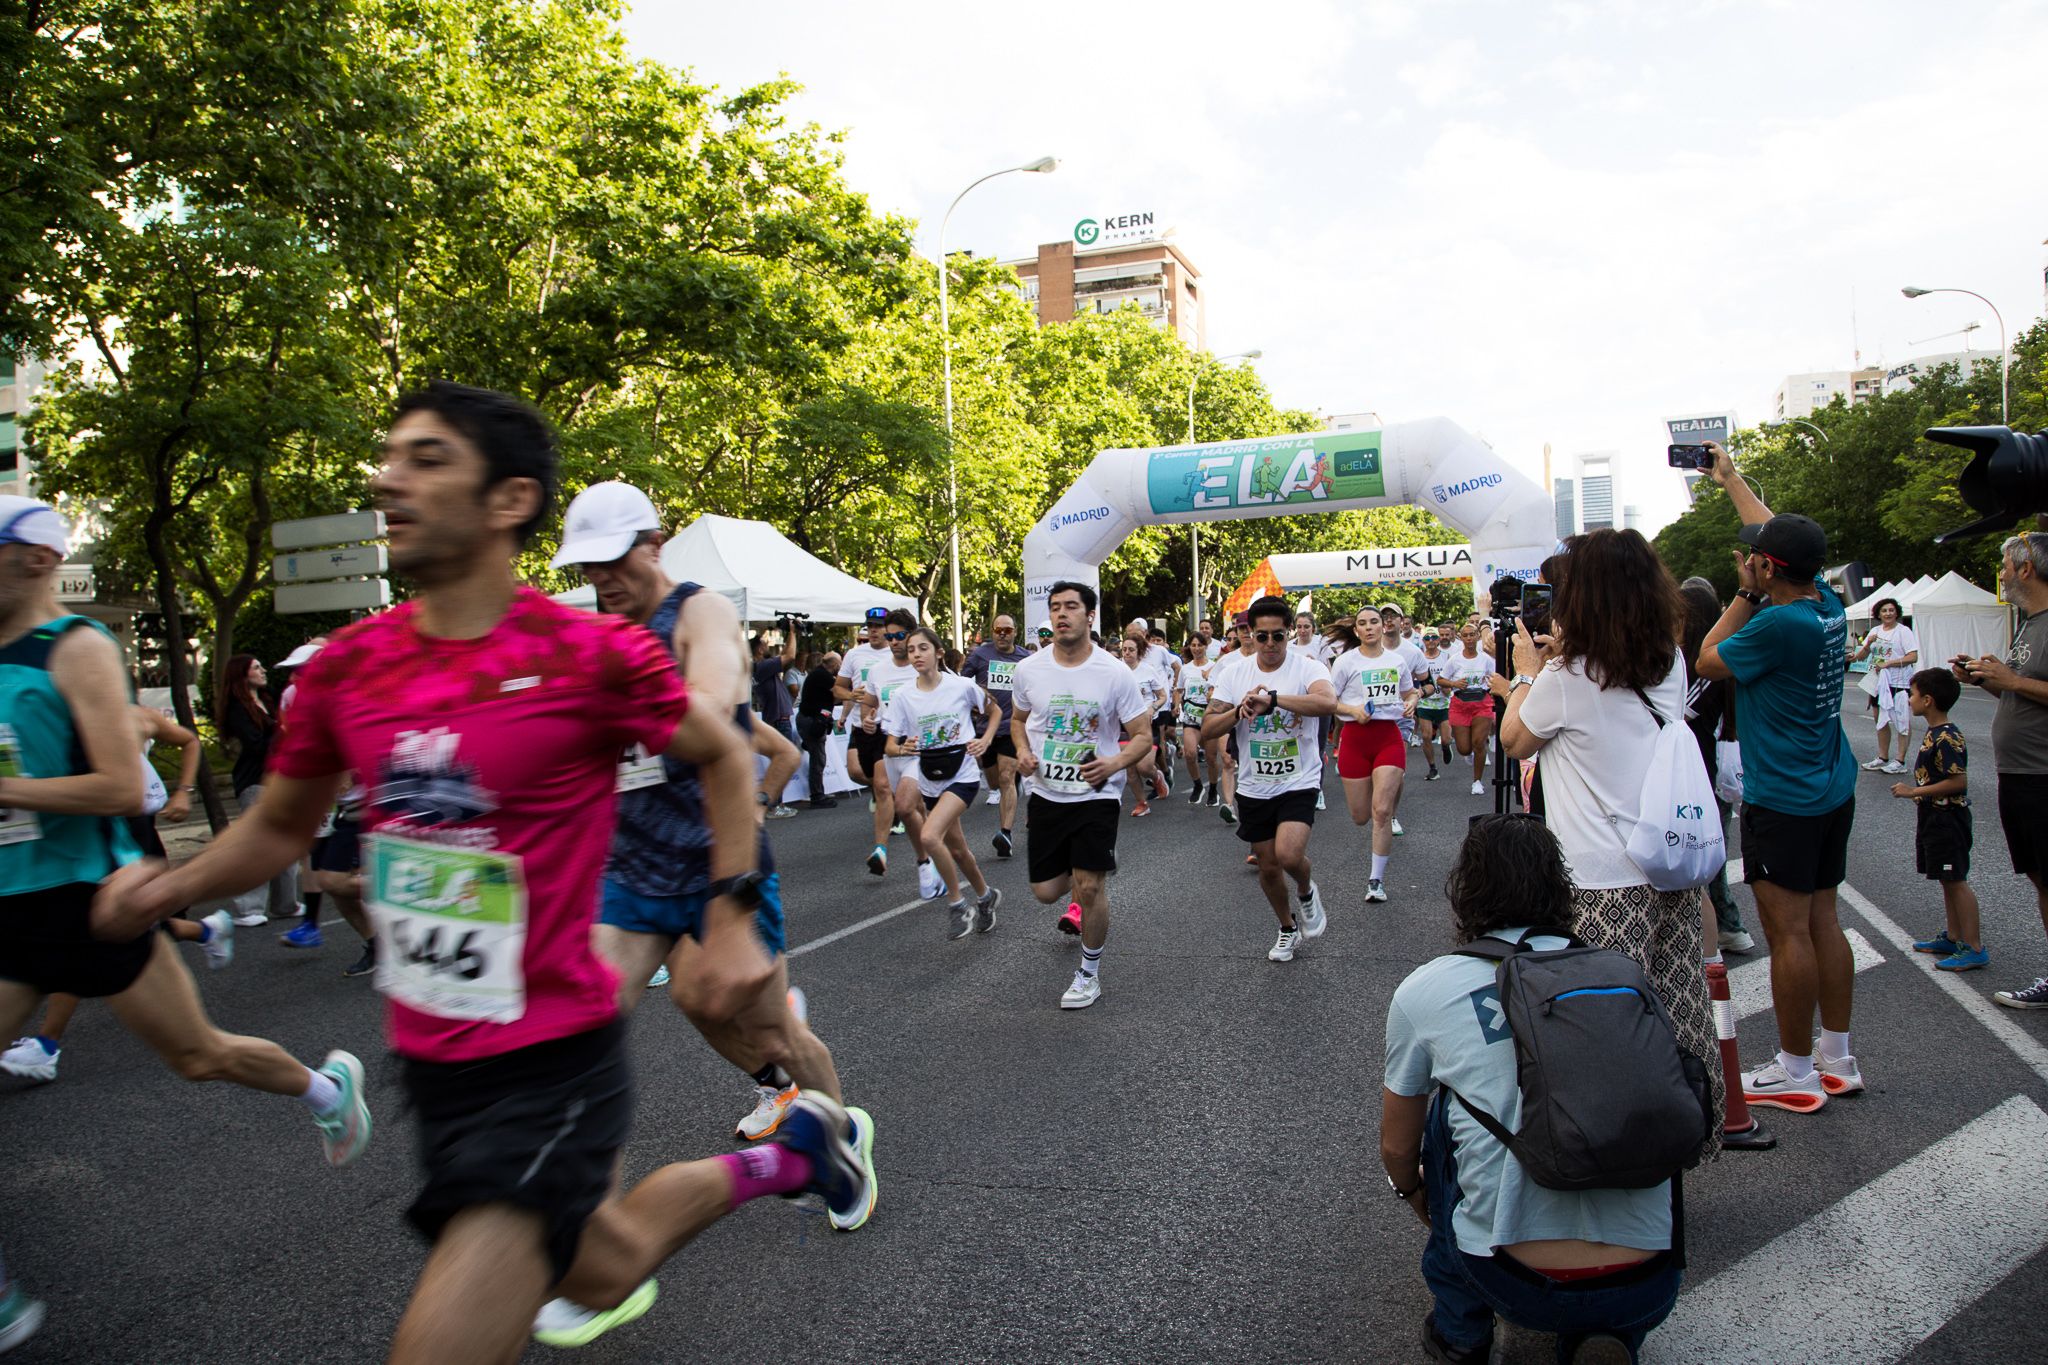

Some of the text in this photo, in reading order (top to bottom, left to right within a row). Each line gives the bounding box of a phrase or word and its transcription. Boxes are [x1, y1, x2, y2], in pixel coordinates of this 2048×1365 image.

[1105, 212, 1154, 230] KERN
[1105, 229, 1155, 240] PHARMA
[1671, 419, 1724, 433] REALIA
[1201, 443, 1258, 457] MADRID
[1262, 440, 1292, 451] CON
[1296, 438, 1315, 448] LA
[1340, 459, 1373, 472] adELA
[1193, 449, 1329, 509] ELA
[1447, 473, 1503, 497] MADRID
[1062, 506, 1110, 526] MADRID
[1379, 571, 1395, 579] FULL
[1408, 569, 1442, 577] COLOURS
[1371, 671, 1393, 683] ELA
[1367, 684, 1396, 698] 1794
[1259, 744, 1289, 758] ELA
[1255, 758, 1296, 776] 1225
